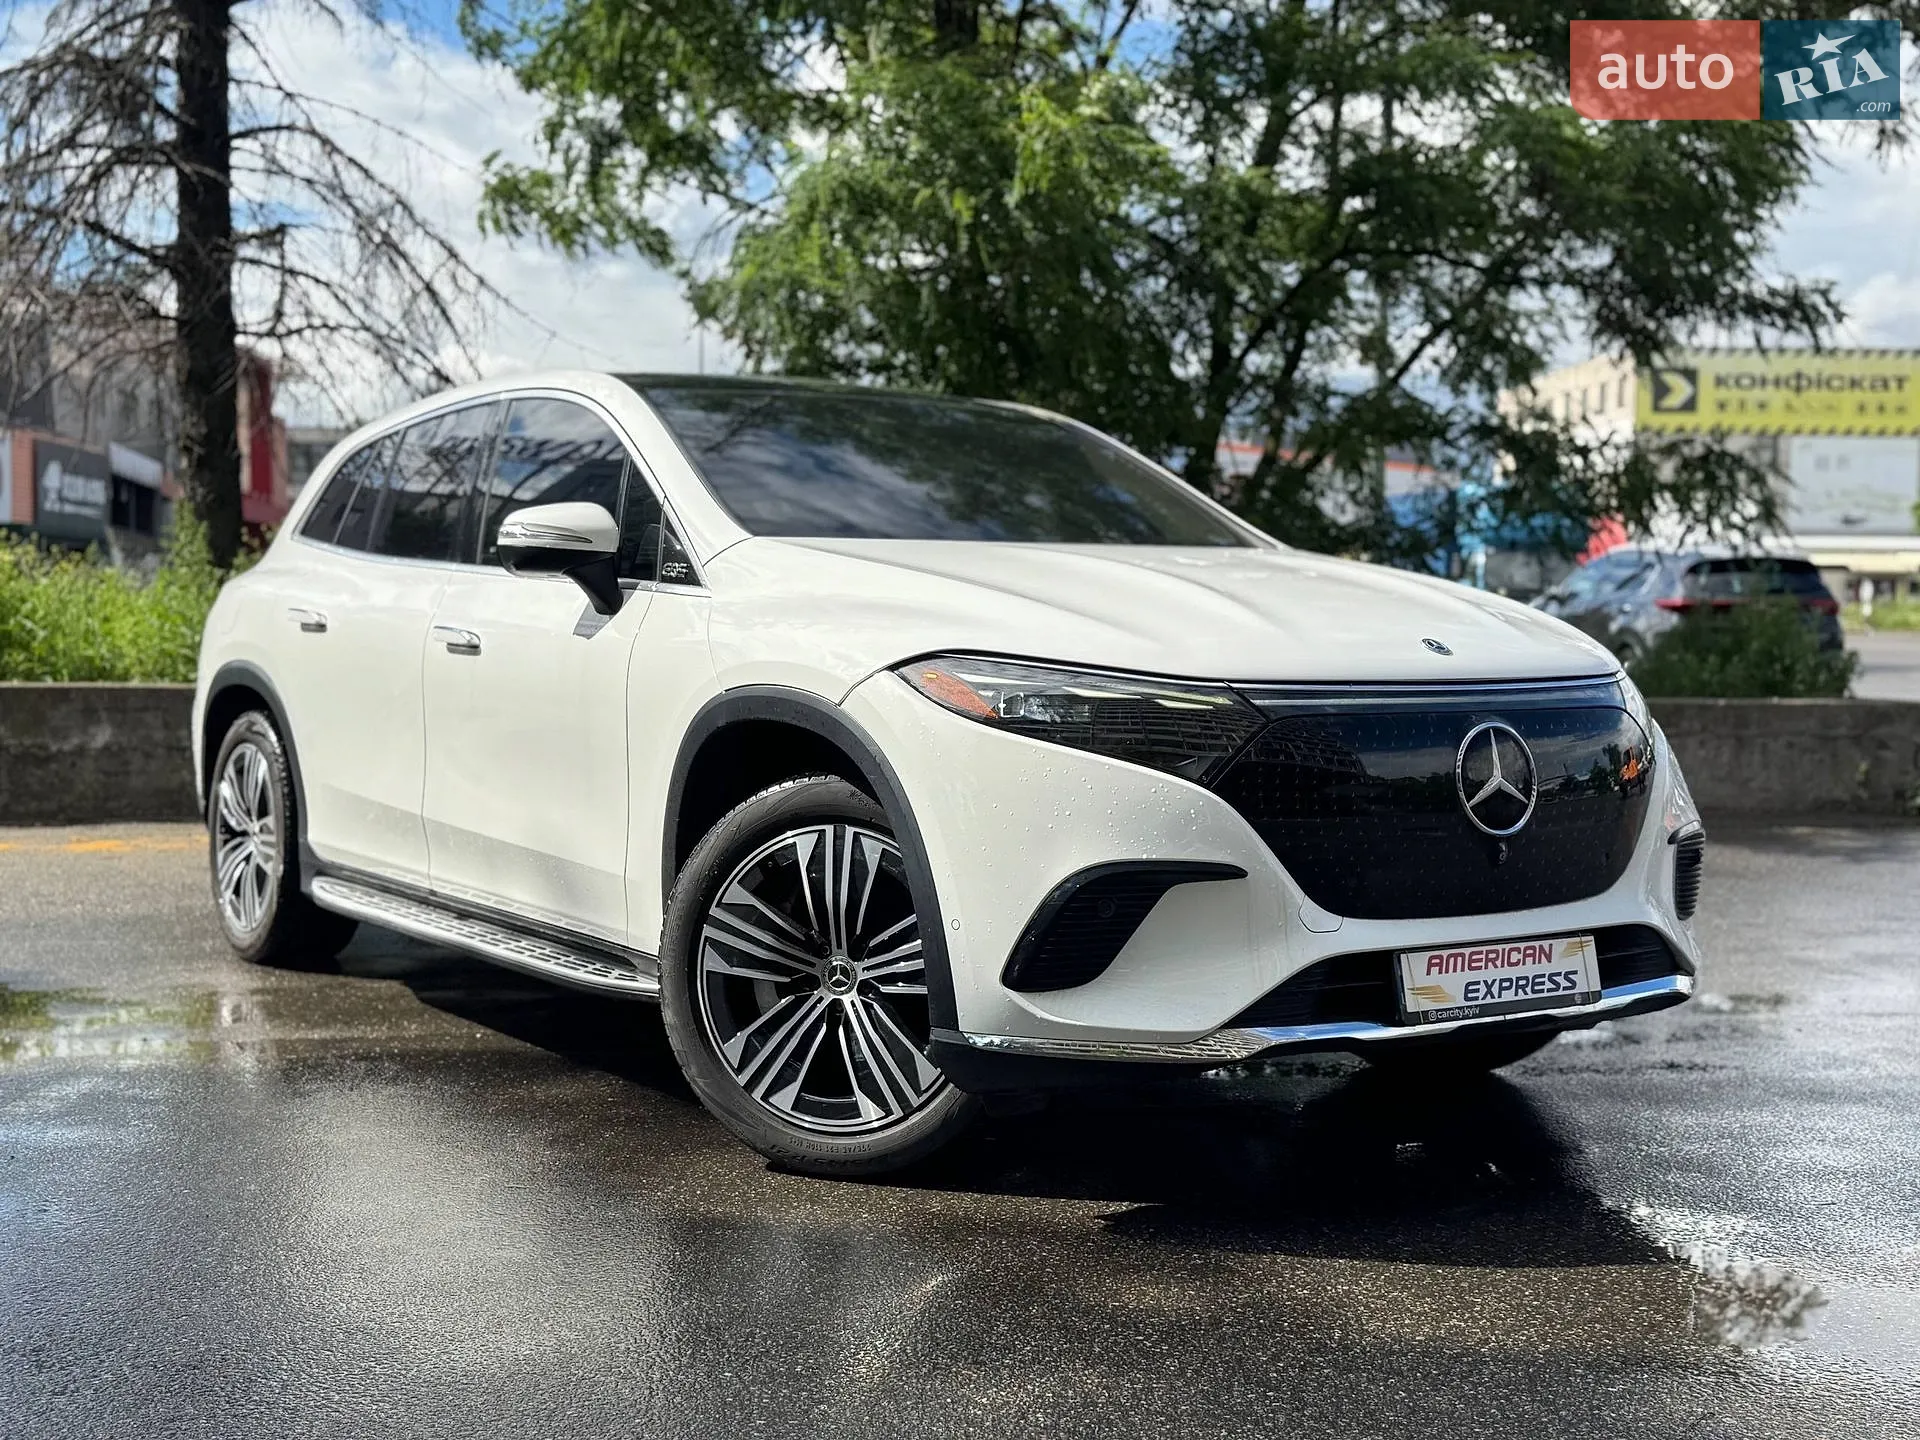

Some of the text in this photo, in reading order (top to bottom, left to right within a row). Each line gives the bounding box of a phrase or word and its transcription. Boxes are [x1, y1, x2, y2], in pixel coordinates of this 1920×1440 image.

[1426, 943, 1553, 976] AMERICAN
[1464, 970, 1578, 1002] EXPRESS
[1428, 1006, 1480, 1021] @carcity.kyiv
